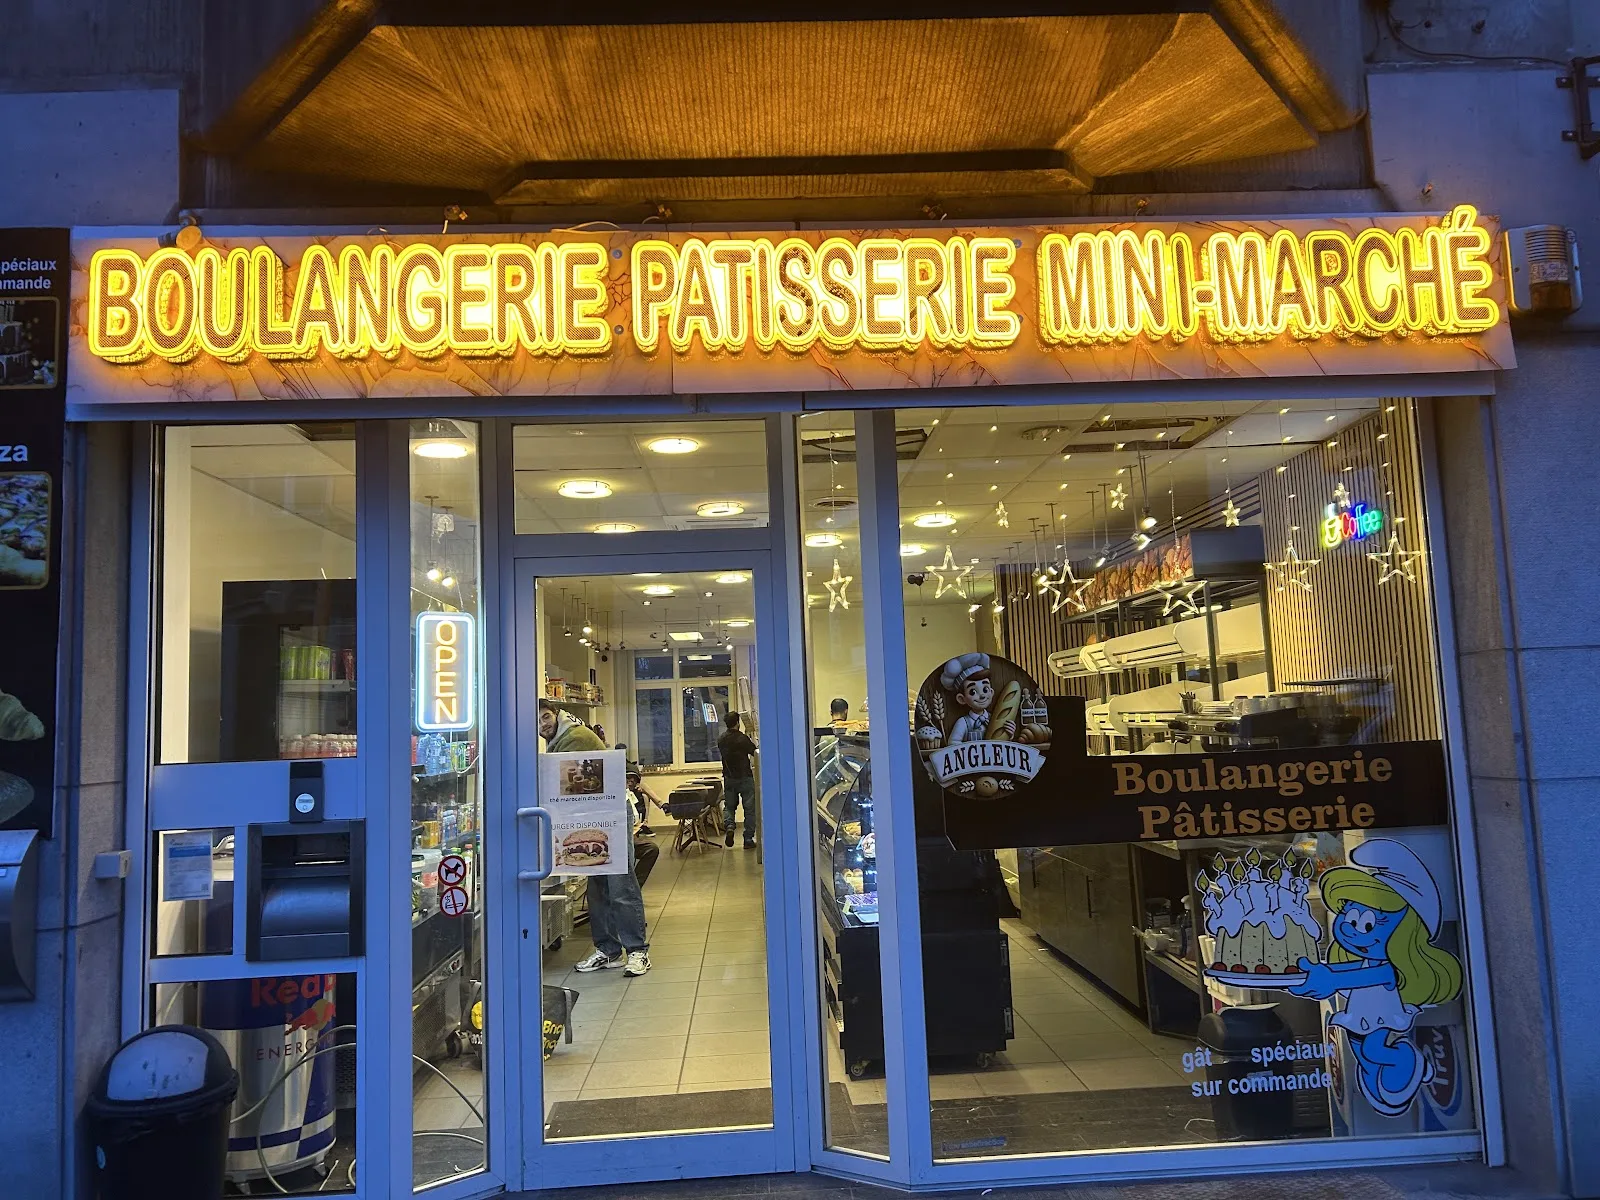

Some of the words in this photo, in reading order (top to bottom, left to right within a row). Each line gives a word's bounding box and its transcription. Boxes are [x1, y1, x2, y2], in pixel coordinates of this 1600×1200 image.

[0, 257, 57, 274] péciaux
[88, 242, 611, 360] BOULANGERIE
[631, 237, 1021, 350] PATISSERIE
[1040, 204, 1502, 340] MINI-MARCHÉ
[1341, 504, 1381, 538] Coffee
[435, 620, 457, 723] OPEN
[942, 743, 1032, 776] ANGLEUR
[1111, 750, 1393, 797] Boulangerie
[587, 794, 616, 802] disponible
[551, 822, 575, 830] URGER
[576, 820, 618, 829] DISPONIBLE
[1137, 795, 1376, 839] Pâtisserie
[251, 974, 321, 1008] Red
[256, 1038, 317, 1061] ENERG
[1181, 1046, 1213, 1073] gât
[1250, 1039, 1336, 1067] spéciaux
[1191, 1079, 1223, 1097] sur
[1227, 1067, 1332, 1095] commande
